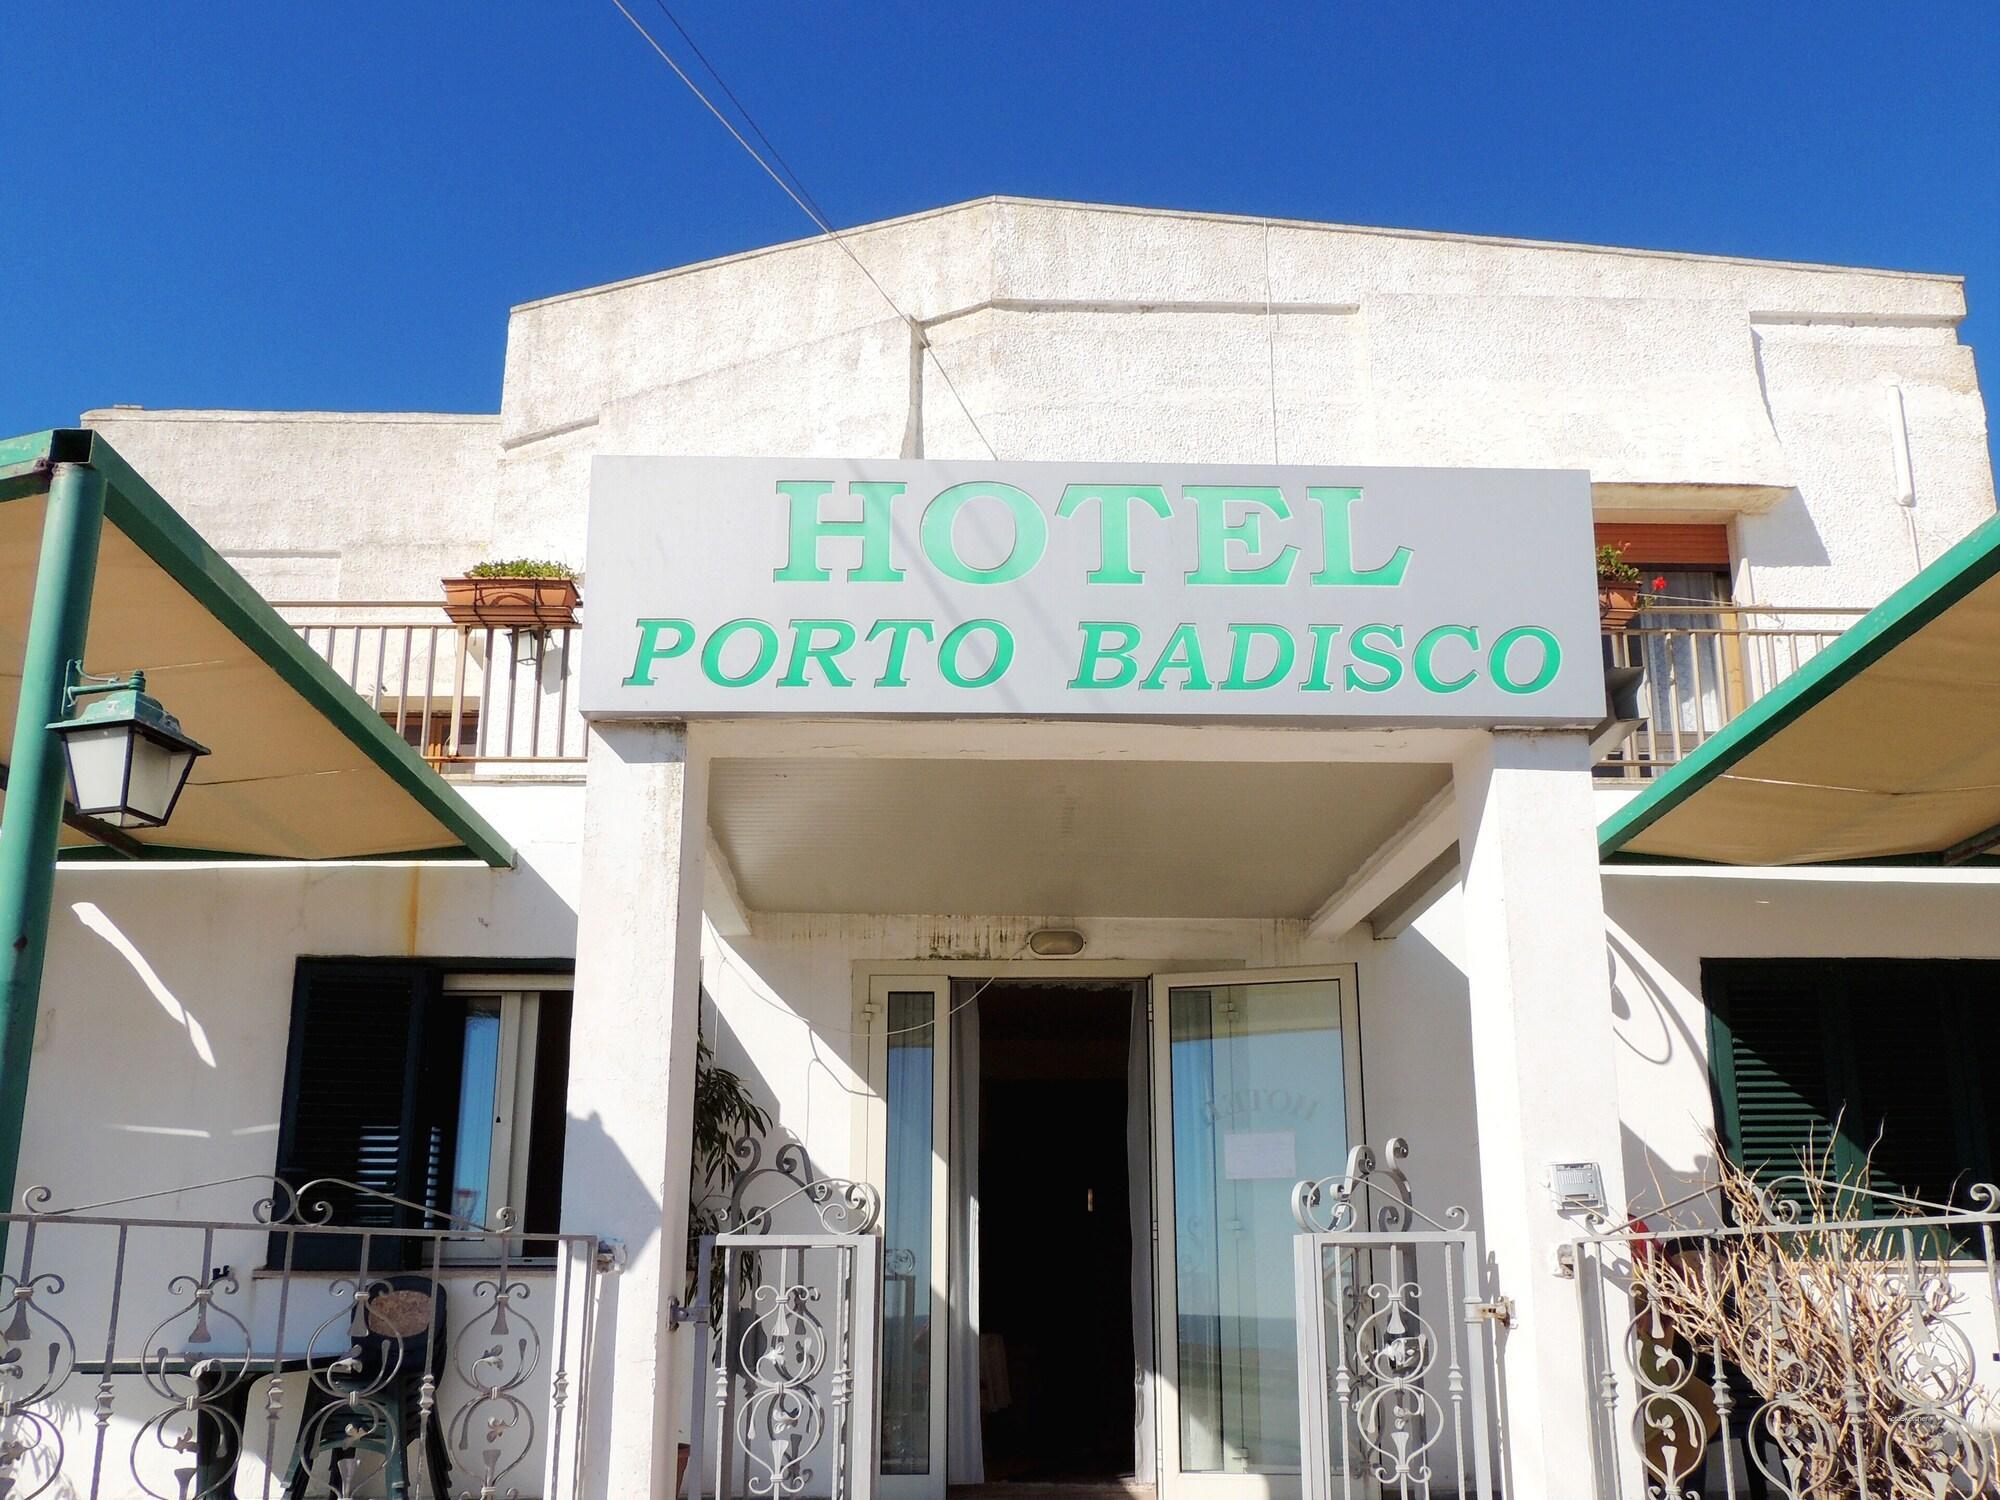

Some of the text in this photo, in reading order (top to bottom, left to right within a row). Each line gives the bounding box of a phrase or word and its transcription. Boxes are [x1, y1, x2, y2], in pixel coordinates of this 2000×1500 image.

[774, 482, 1412, 587] HOTEL
[622, 618, 1563, 695] PORTO BADISCO
